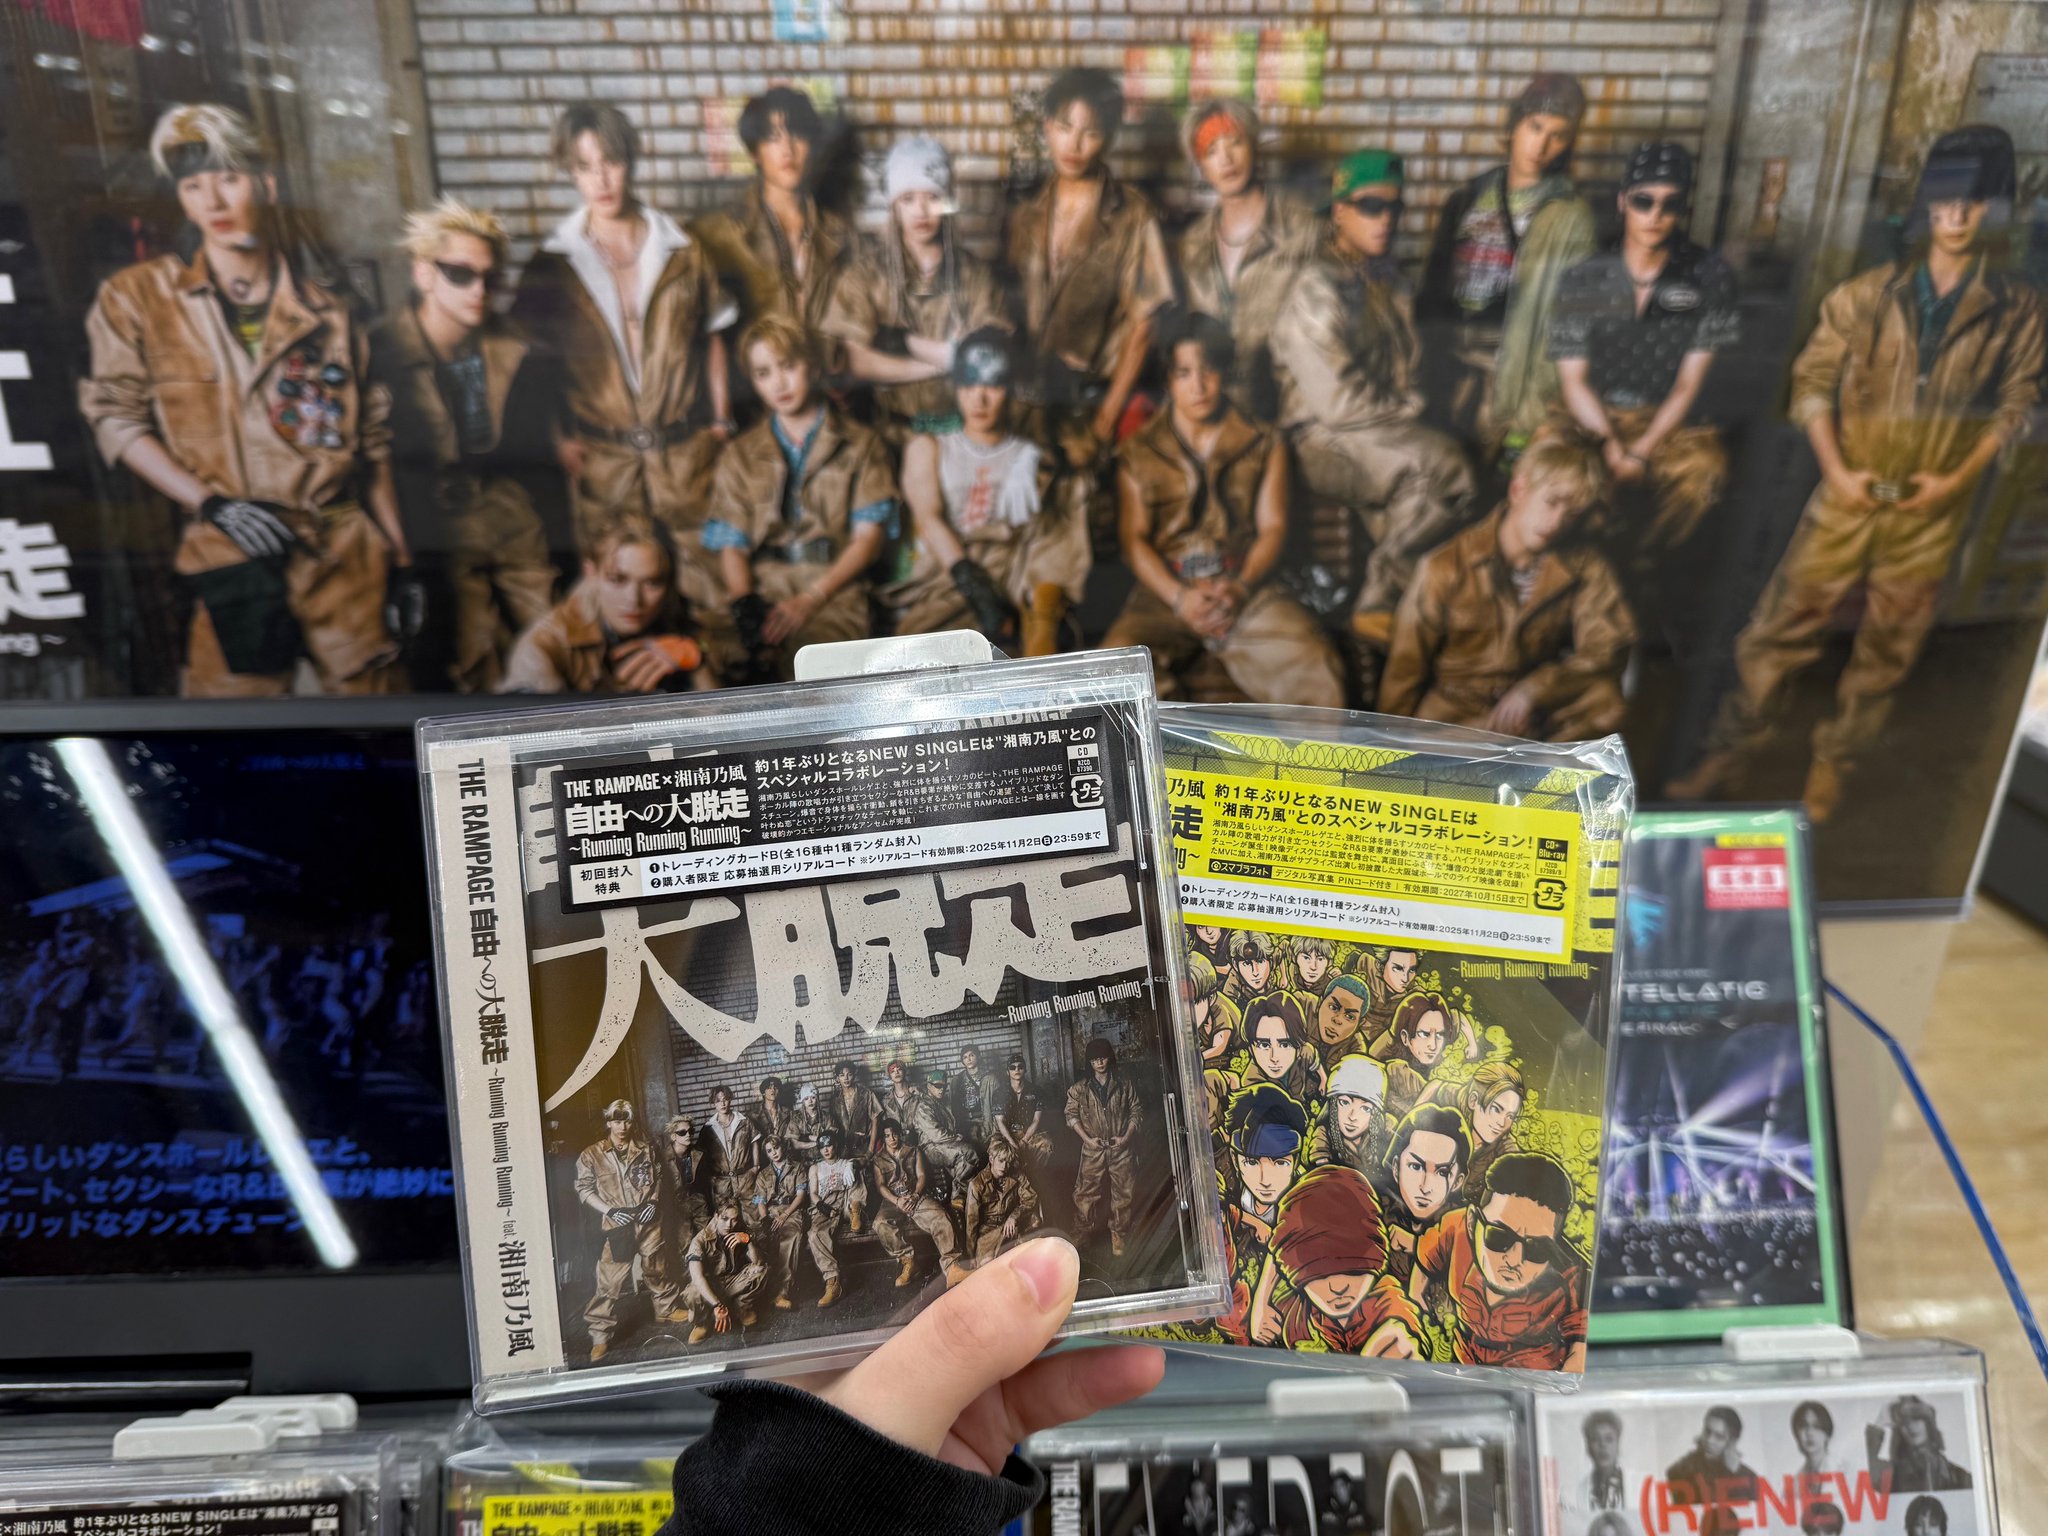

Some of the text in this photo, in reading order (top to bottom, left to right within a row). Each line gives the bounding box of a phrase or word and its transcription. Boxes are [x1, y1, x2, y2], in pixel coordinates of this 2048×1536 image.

[755, 745, 908, 774] 約1年ぶりとなるNEW
[1077, 747, 1088, 756] CD
[458, 758, 487, 799] THE
[757, 758, 950, 789] スペシャルコラボレーション!
[1022, 764, 1064, 774] RAMPAGE
[564, 780, 592, 798] THE
[566, 787, 751, 836] 自由への大脱走
[1215, 783, 1478, 826] 約1年ぶりとなるNEW SINGLEは
[637, 829, 687, 852] Running
[462, 804, 495, 905] RAMPAGE
[1538, 850, 1566, 862] Blu-ray
[580, 864, 633, 881] 初回封入
[724, 856, 856, 881] 応募抽選用シリアルコード
[1221, 861, 1270, 876] スマプラフォト
[1275, 870, 1391, 890] デジタル写真集 PINコード付き
[595, 881, 621, 895] 特典
[1237, 902, 1346, 922] 応募抽選用シリアルコード
[1504, 960, 1545, 980] Running
[470, 908, 509, 1065] 自由への大脱走
[1053, 989, 1097, 1013] Running
[492, 1121, 511, 1163] Running
[499, 1240, 535, 1357] 湘南乃風
[1640, 1469, 1893, 1536] (R)ENEW
[73, 1511, 195, 1528] 約1年ぶりとなるNEW
